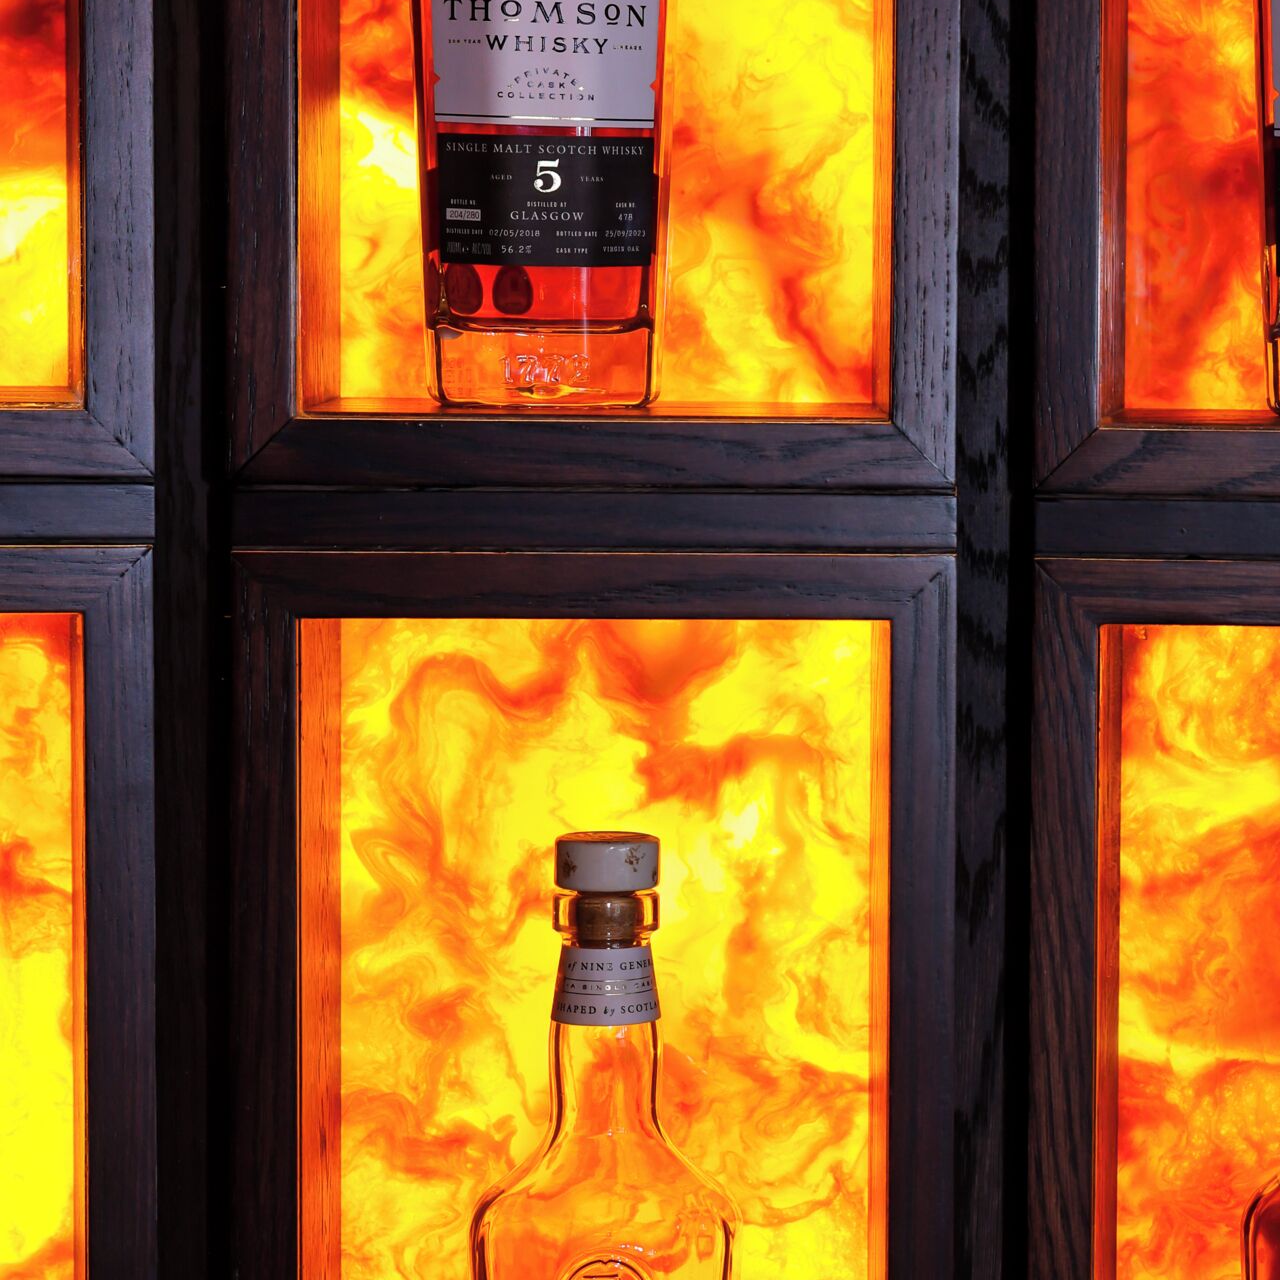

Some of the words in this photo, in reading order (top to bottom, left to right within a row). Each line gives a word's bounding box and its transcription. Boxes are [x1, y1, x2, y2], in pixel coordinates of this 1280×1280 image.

[486, 34, 609, 55] WHISKY
[513, 67, 578, 87] PRIVATE
[527, 81, 566, 89] CASK
[497, 91, 595, 101] COLLECTION
[446, 142, 488, 153] SINGLE
[493, 143, 532, 155] MALT
[538, 144, 597, 156] SCOTCH
[602, 145, 645, 157] WHISKY
[533, 158, 562, 194] 5
[510, 210, 584, 221] GLASGOW
[489, 229, 541, 238] 02/05/2018
